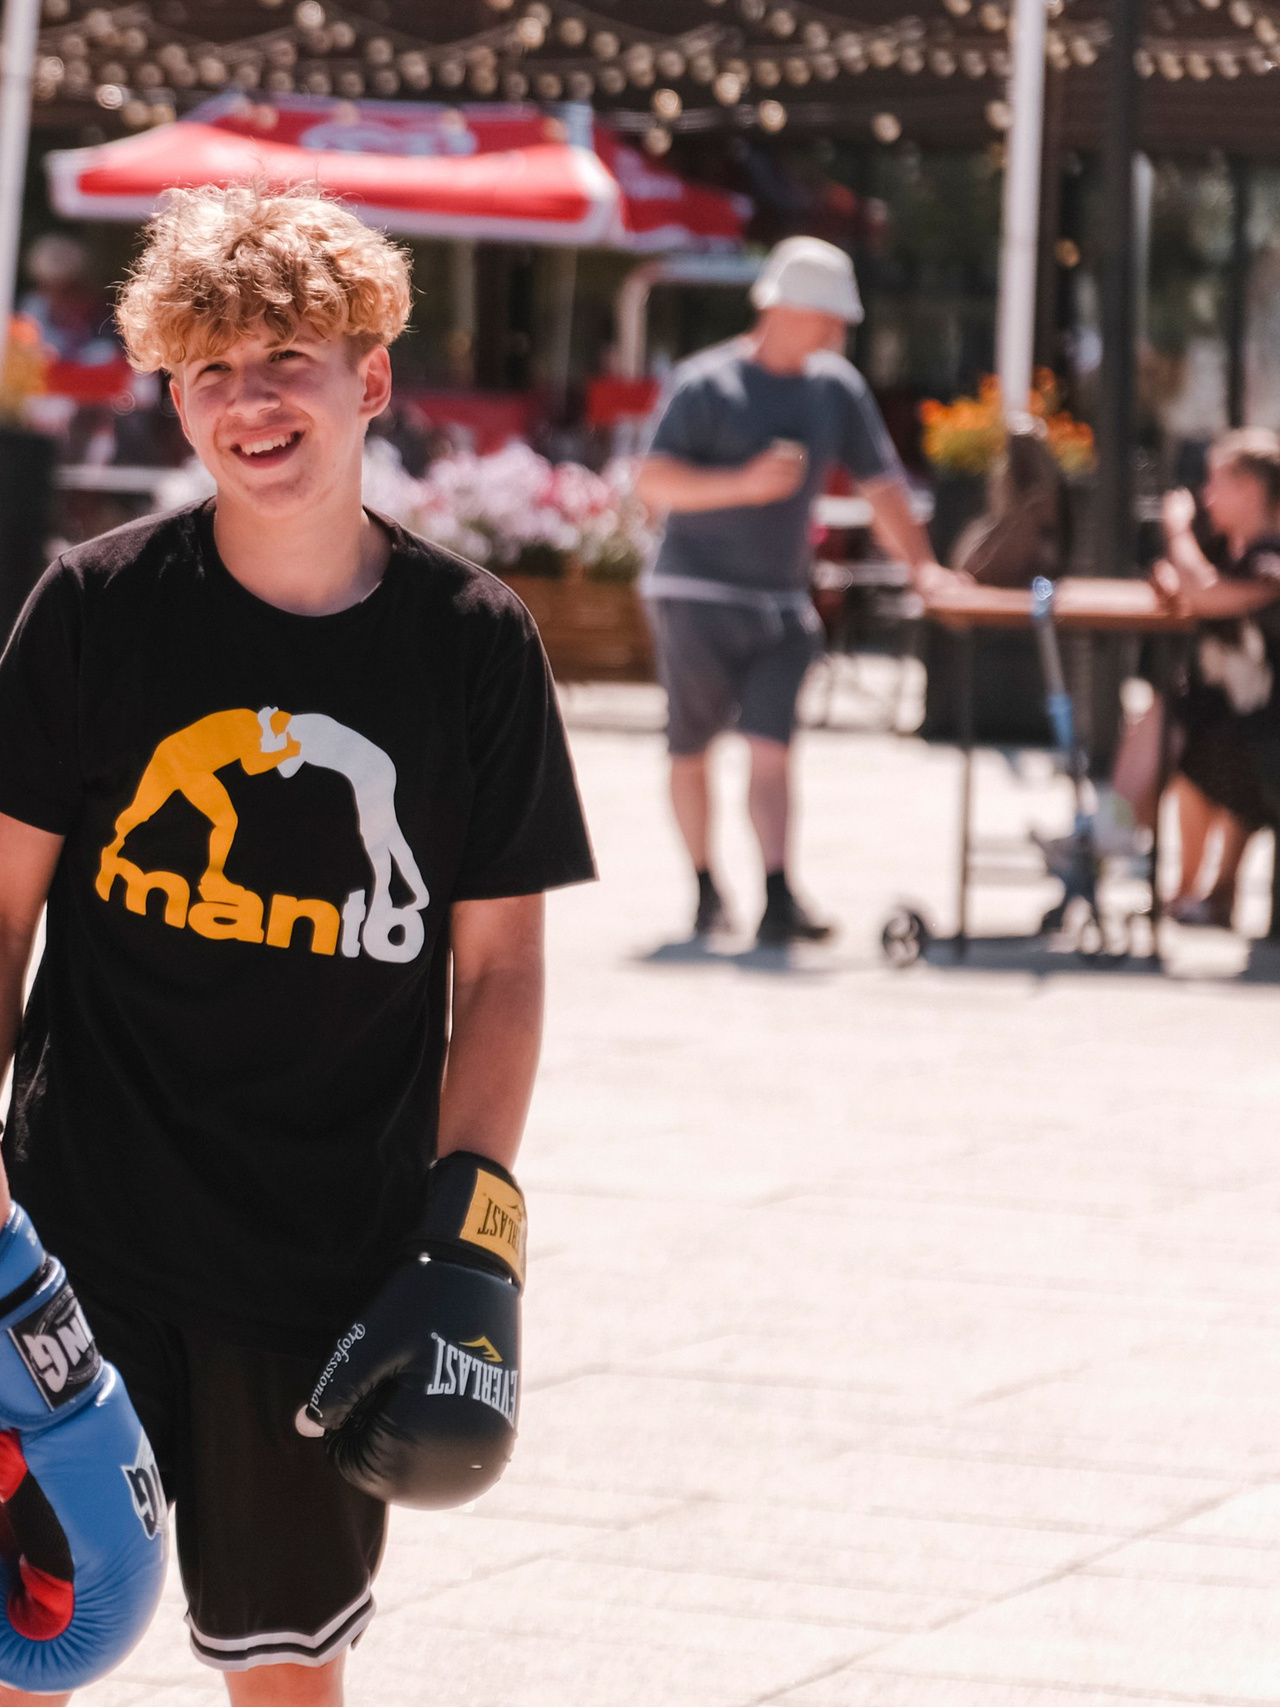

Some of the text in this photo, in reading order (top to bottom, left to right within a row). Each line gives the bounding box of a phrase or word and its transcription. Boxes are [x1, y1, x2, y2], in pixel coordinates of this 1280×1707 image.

[95, 847, 425, 963] manto
[310, 1323, 366, 1418] Professional
[427, 1336, 518, 1430] EVERLAST
